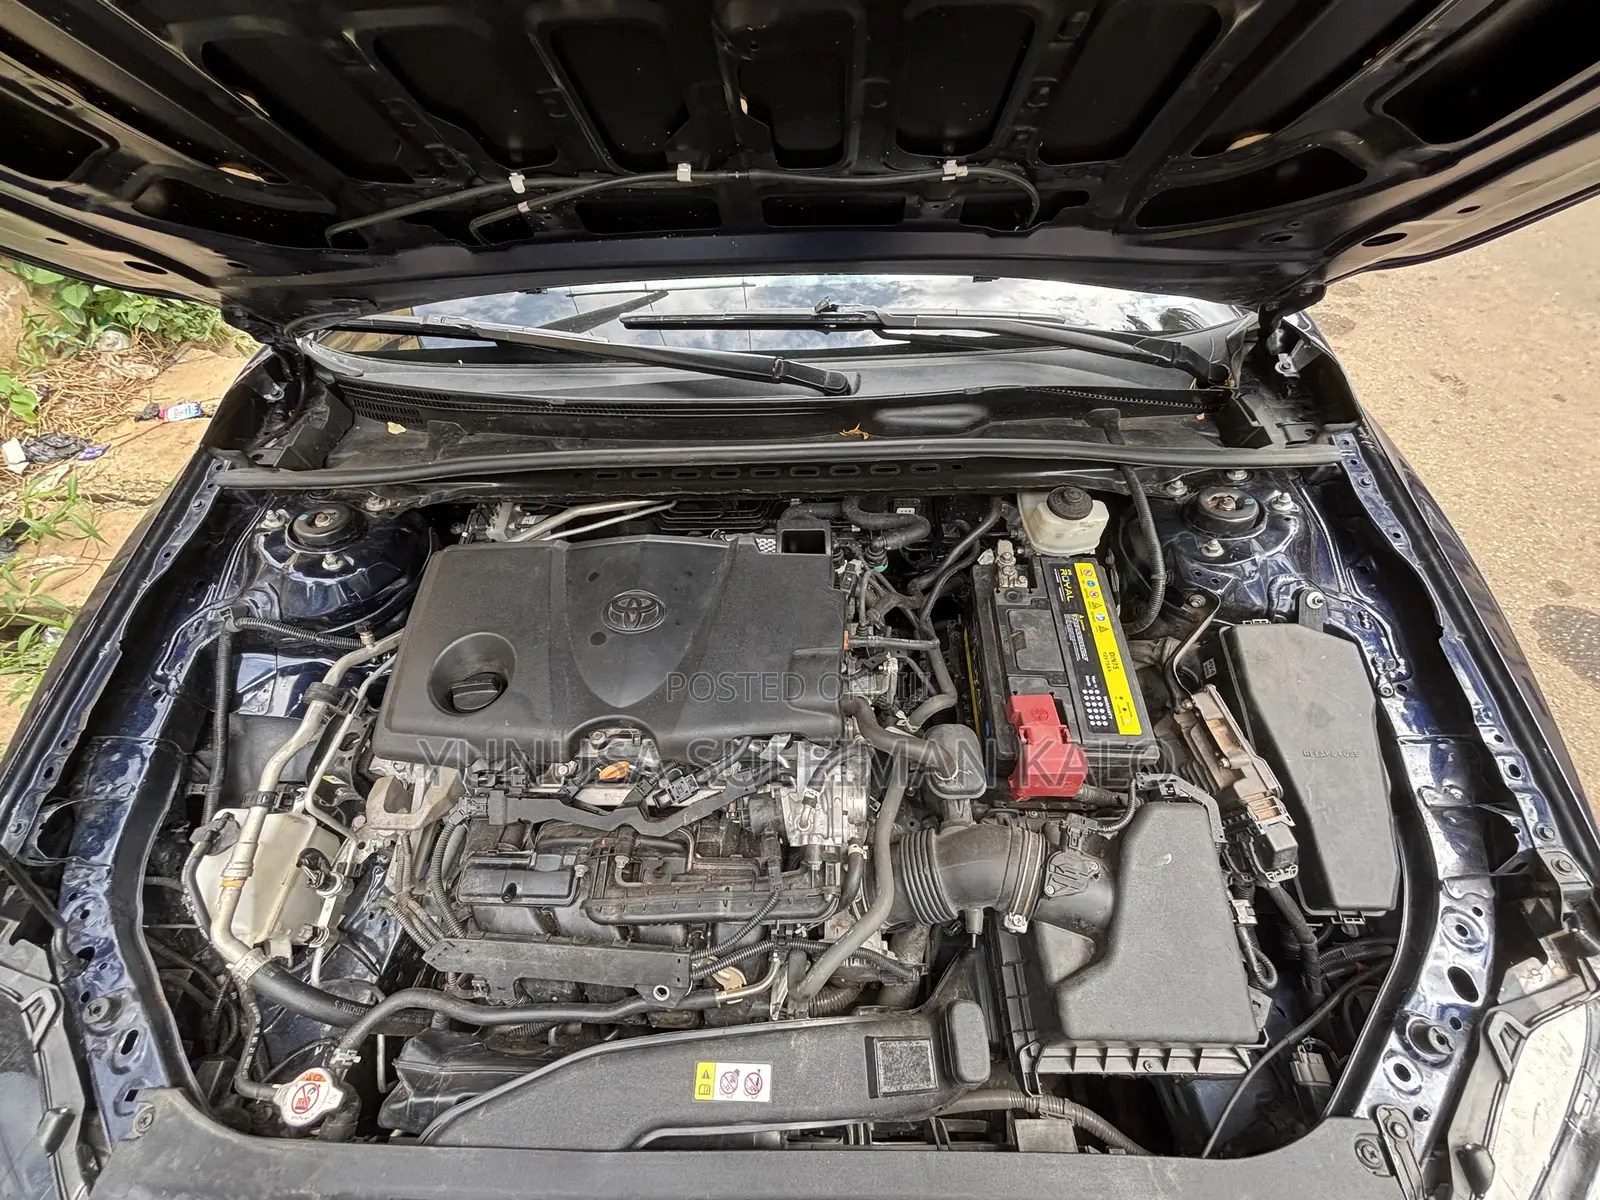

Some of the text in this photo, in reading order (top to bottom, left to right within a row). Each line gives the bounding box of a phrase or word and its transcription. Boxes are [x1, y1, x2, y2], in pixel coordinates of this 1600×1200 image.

[1060, 568, 1075, 602] ROYAL
[1302, 750, 1329, 758] RELAY
[1337, 750, 1359, 758] FUSE
